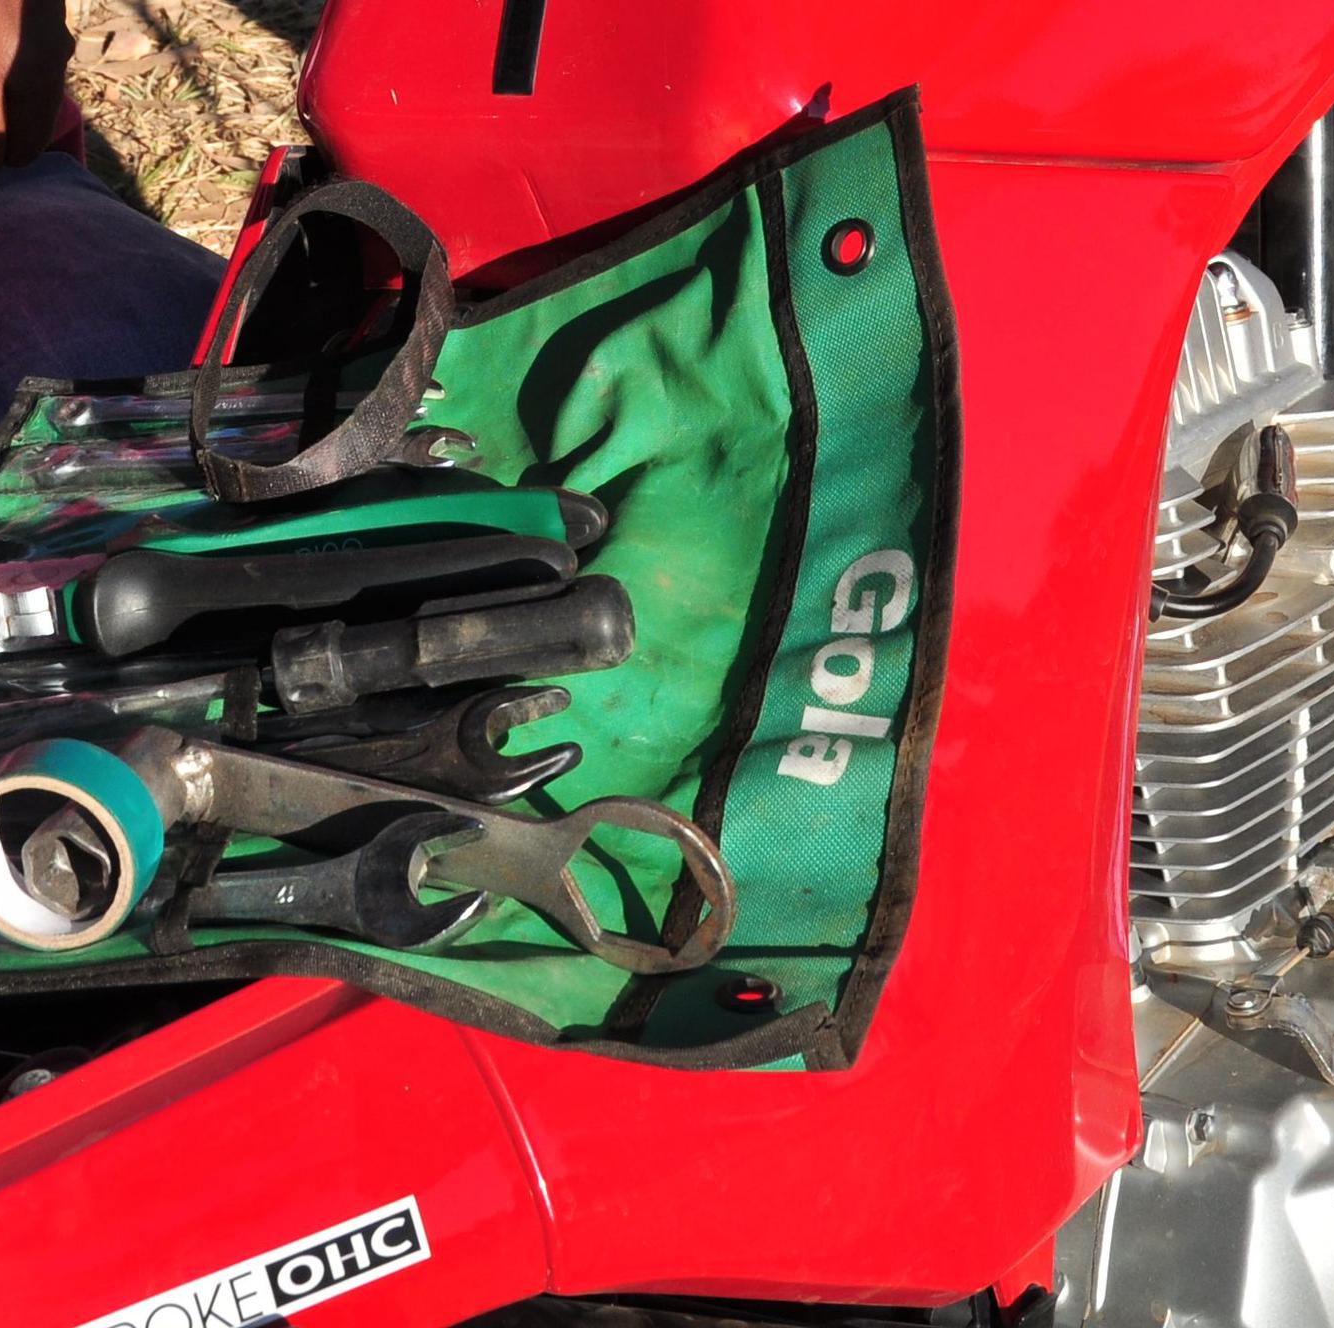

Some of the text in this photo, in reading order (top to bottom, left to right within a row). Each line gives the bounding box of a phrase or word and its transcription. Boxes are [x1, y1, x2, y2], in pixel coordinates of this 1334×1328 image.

[777, 548, 915, 786] Gola
[105, 1216, 414, 1328] OKE OHC
